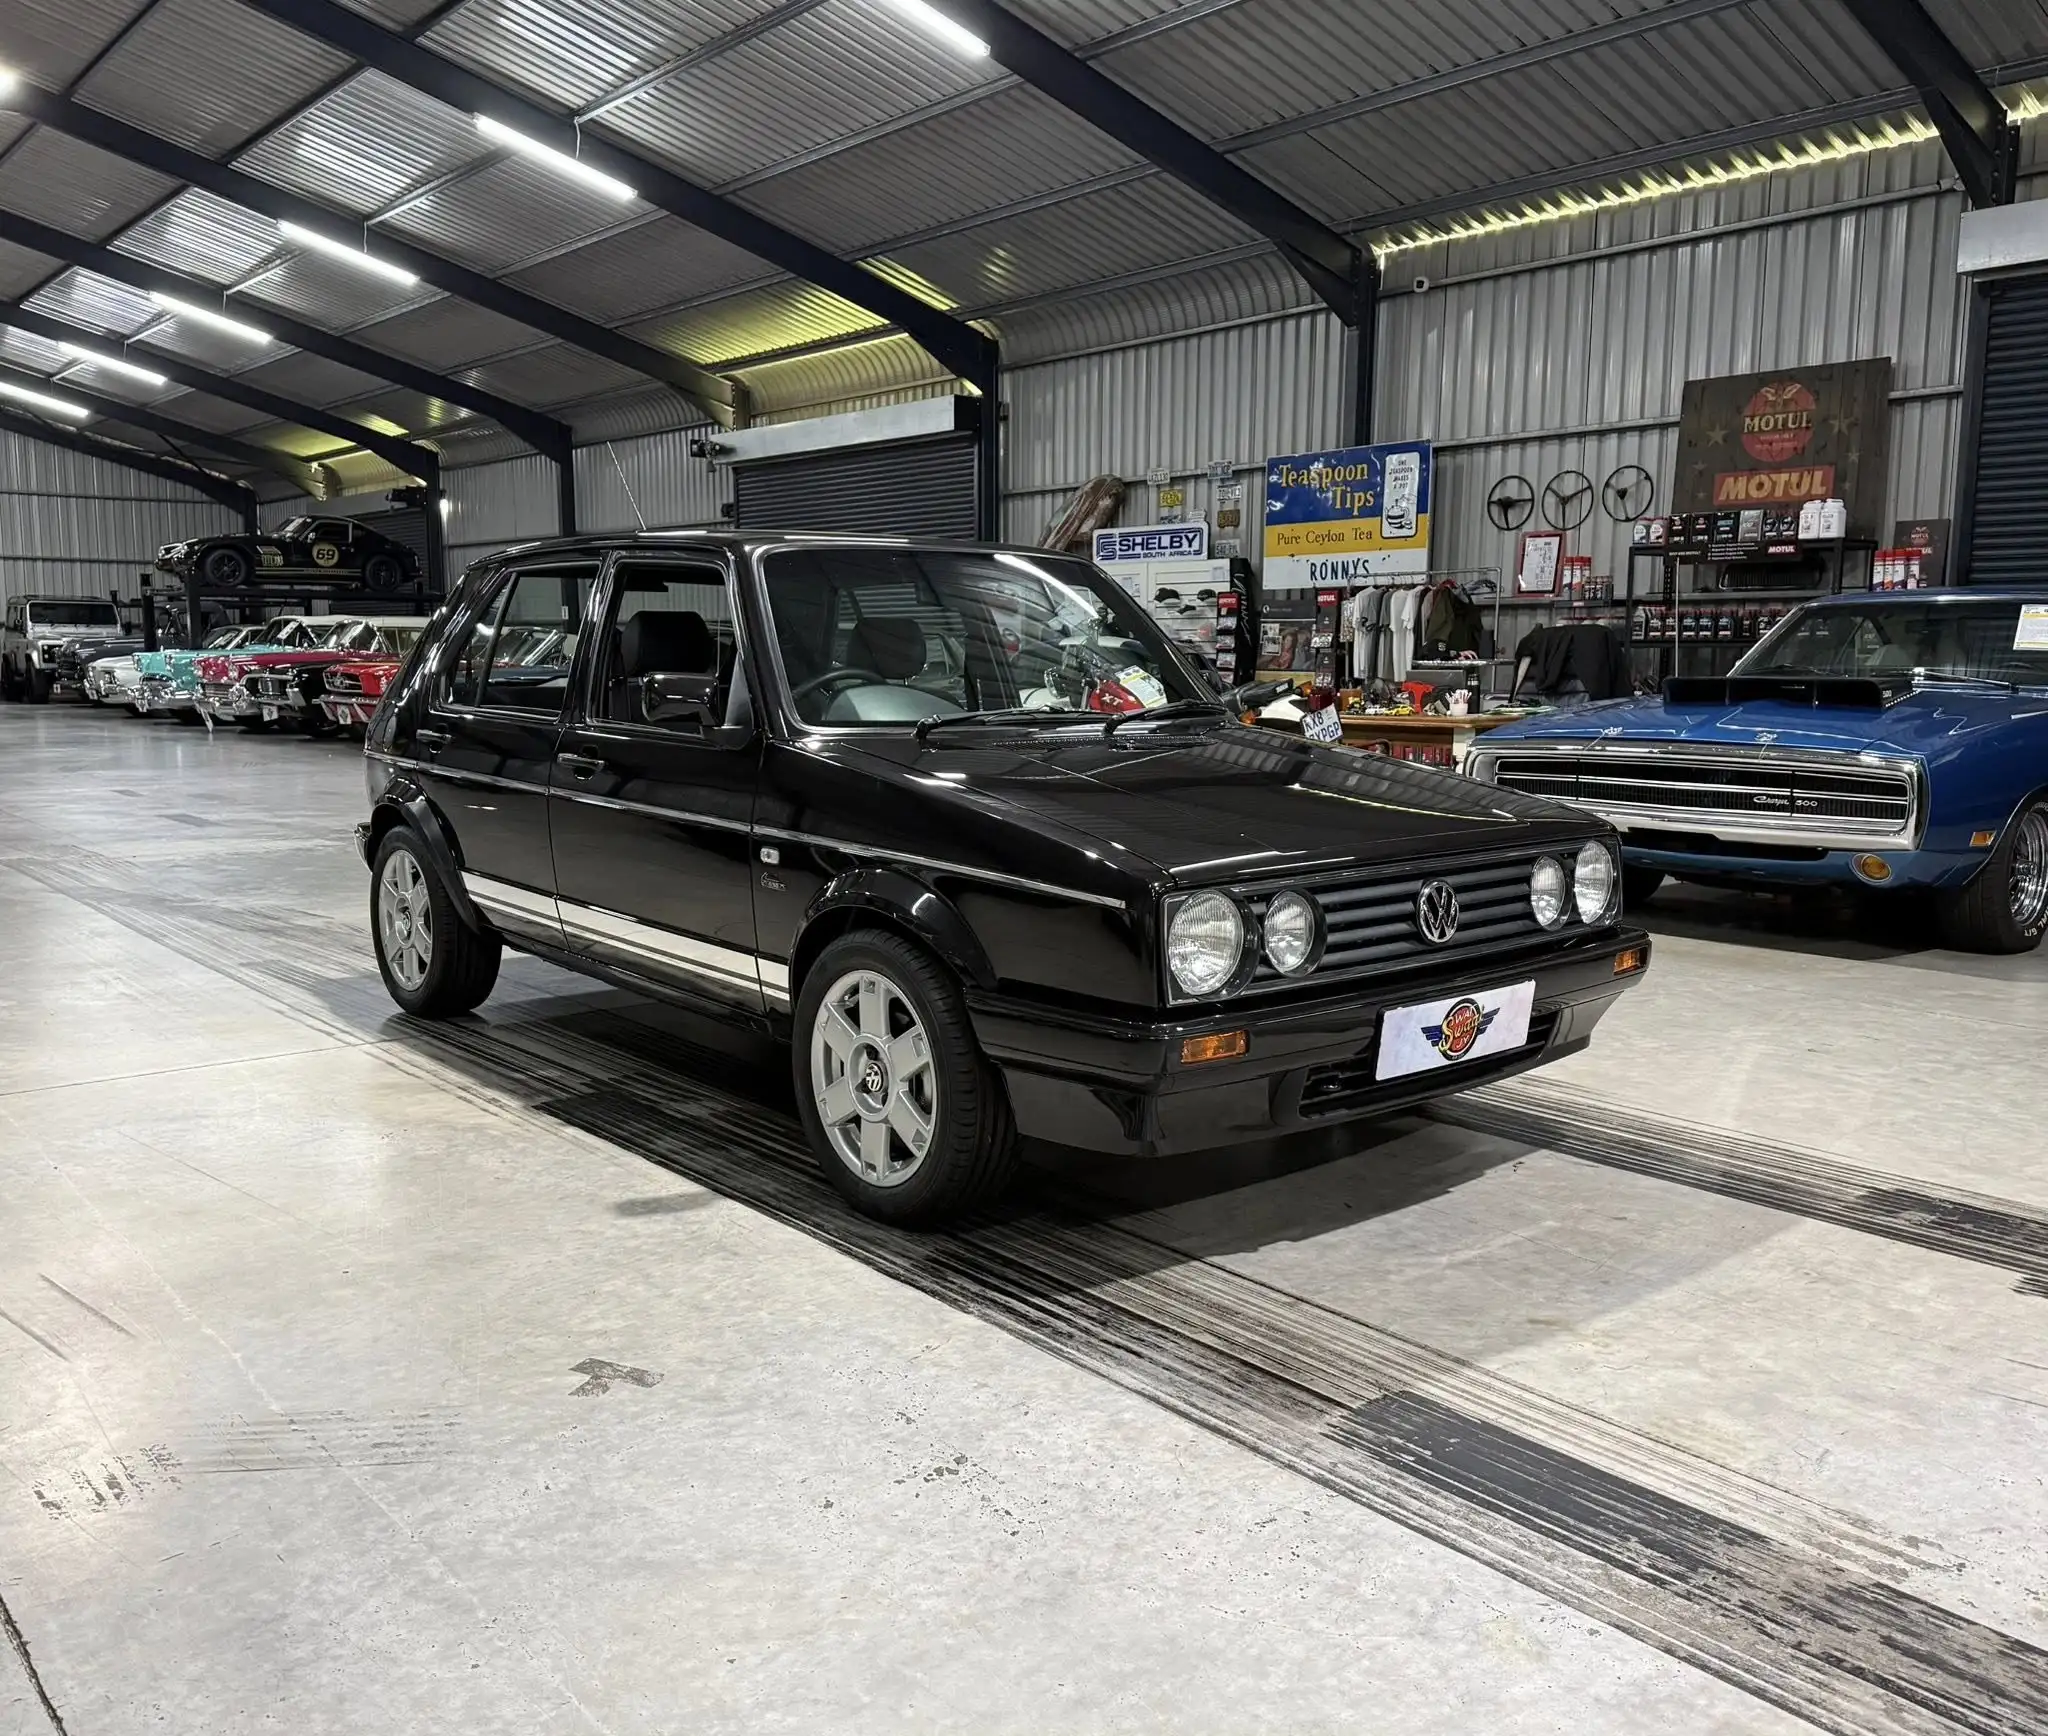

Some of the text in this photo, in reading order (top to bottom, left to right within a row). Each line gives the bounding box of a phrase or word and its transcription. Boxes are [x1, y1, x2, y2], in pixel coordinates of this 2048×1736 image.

[1744, 411, 1812, 433] MOTUL
[1279, 462, 1369, 489] Teaspoon
[1718, 470, 1827, 500] MOTUL
[1331, 485, 1375, 515] Tips
[1118, 533, 1198, 552] SHELBY
[1277, 527, 1373, 546] Pure Ceylon Tea
[316, 548, 336, 560] 69
[1142, 551, 1166, 559] SOUTH
[1767, 545, 1795, 554] MOTUL
[1310, 559, 1370, 581] RONNYS
[1101, 692, 1123, 706] XT
[1795, 799, 1818, 807] 500
